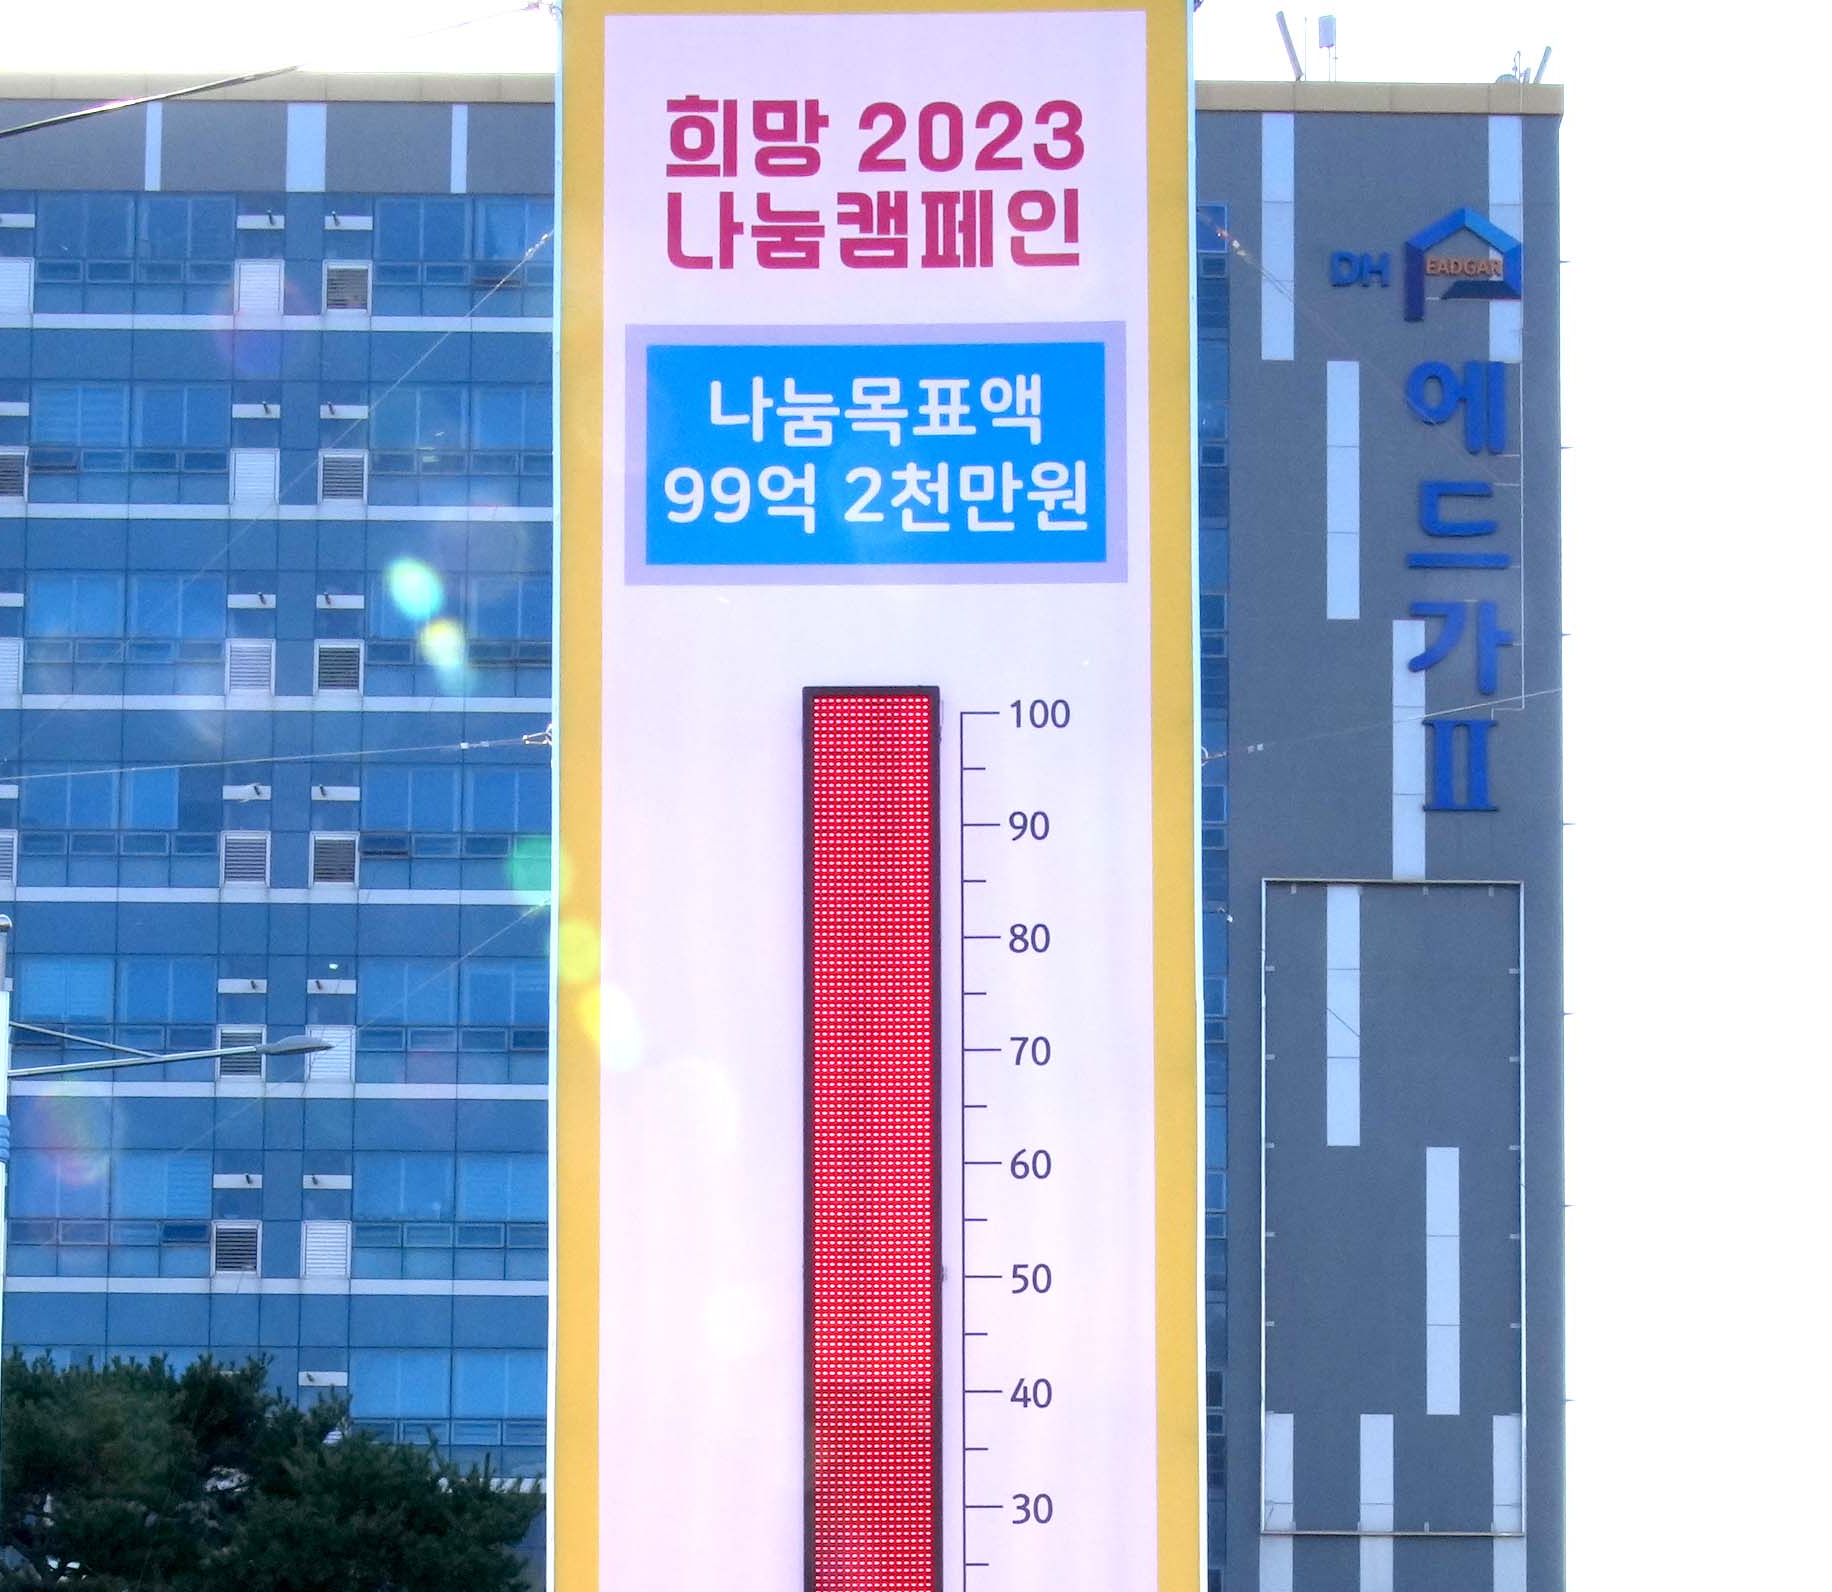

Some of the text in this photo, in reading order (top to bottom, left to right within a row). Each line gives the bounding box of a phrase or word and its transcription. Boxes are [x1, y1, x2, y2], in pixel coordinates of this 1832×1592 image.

[666, 95, 1085, 179] 희망 2023
[668, 189, 1081, 270] 나눔캠페인
[1330, 251, 1391, 288] DH
[1425, 255, 1504, 277] EADGAR
[710, 374, 1043, 449] 나눔목표액
[665, 460, 1089, 536] 99억 2천만원
[1010, 699, 1071, 730] 100
[1009, 811, 1051, 842] 90
[1009, 924, 1051, 954] 80
[1010, 1036, 1052, 1067] 70
[1010, 1149, 1053, 1180] 60
[1011, 1263, 1053, 1295] 50
[1010, 1378, 1054, 1409] 40
[1012, 1494, 1054, 1525] 30
